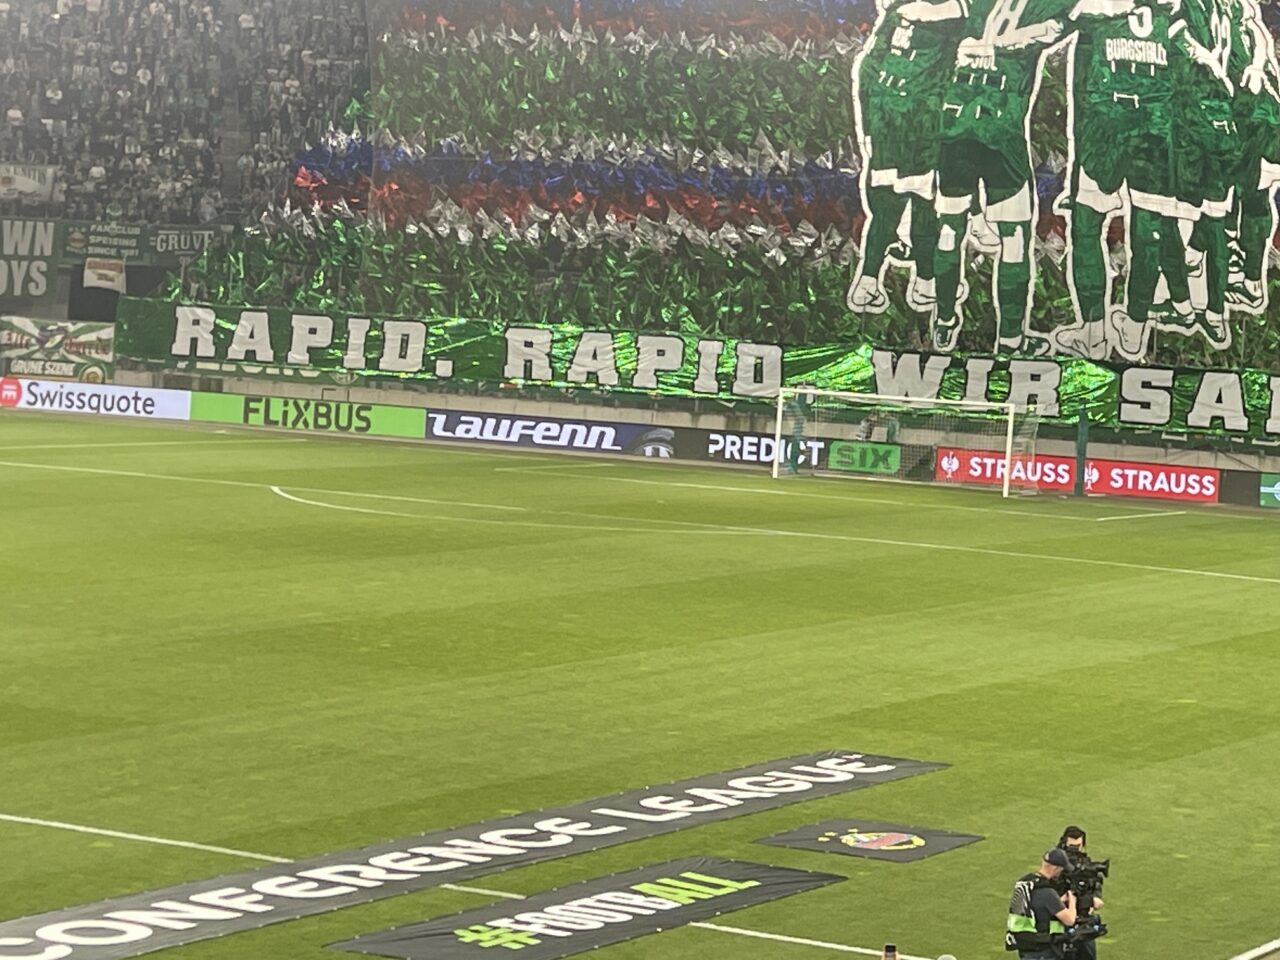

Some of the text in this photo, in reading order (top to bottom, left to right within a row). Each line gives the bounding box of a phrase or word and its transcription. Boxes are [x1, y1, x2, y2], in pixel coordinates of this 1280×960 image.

[171, 306, 453, 378] RAPID.
[504, 327, 782, 397] RAPID
[872, 349, 1061, 417] WIR
[26, 381, 155, 415] Swissquote
[707, 432, 893, 469] PREDICT SIX
[968, 456, 1070, 484] STRAUSS
[1110, 468, 1216, 496] STRAUSS
[592, 756, 898, 822] LEAGUE
[453, 872, 761, 949] #FOOTBALL
